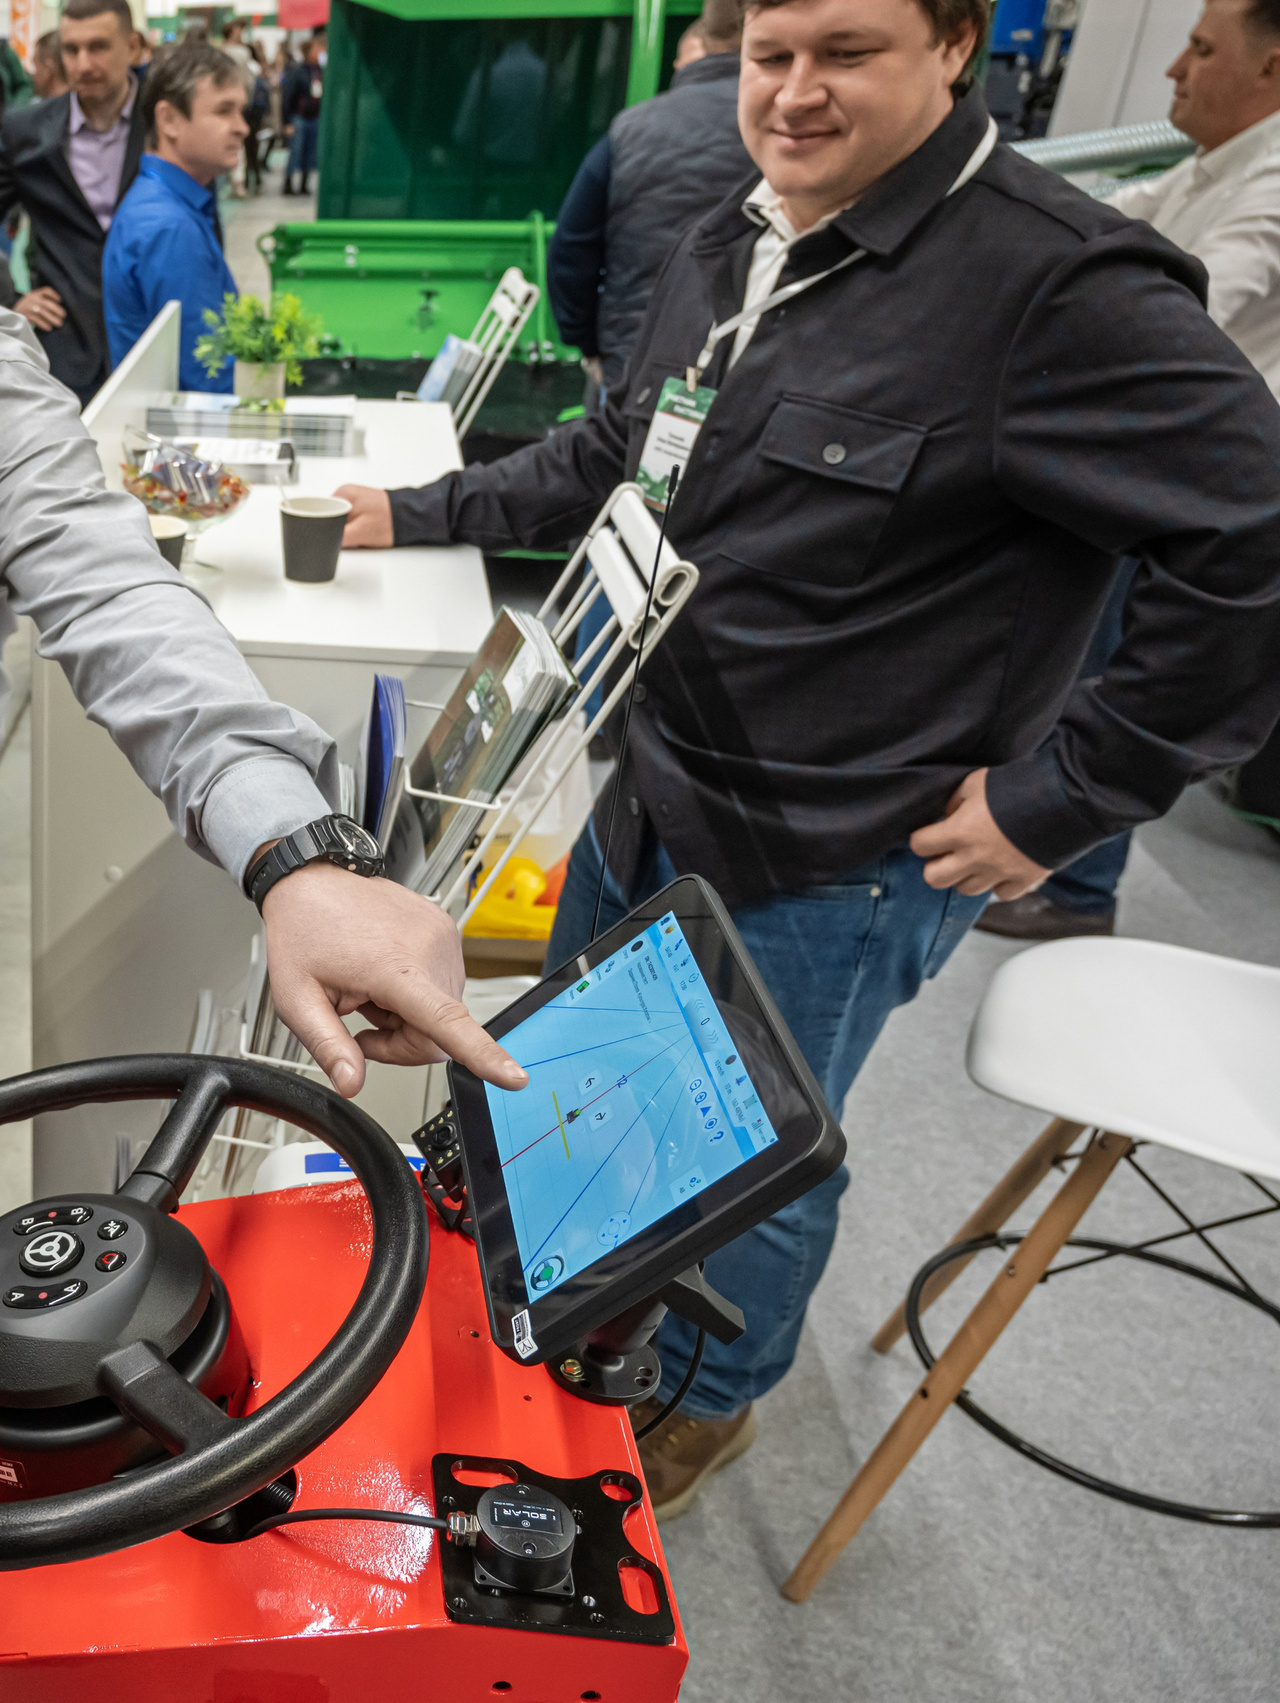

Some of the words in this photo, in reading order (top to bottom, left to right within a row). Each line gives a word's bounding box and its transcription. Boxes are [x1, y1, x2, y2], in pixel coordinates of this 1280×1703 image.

[701, 1017, 709, 1026] 0
[617, 1073, 628, 1088] 12
[71, 1207, 84, 1216] B
[22, 1217, 34, 1226] B
[11, 1292, 24, 1301] A
[502, 1508, 548, 1520] SOLAR
